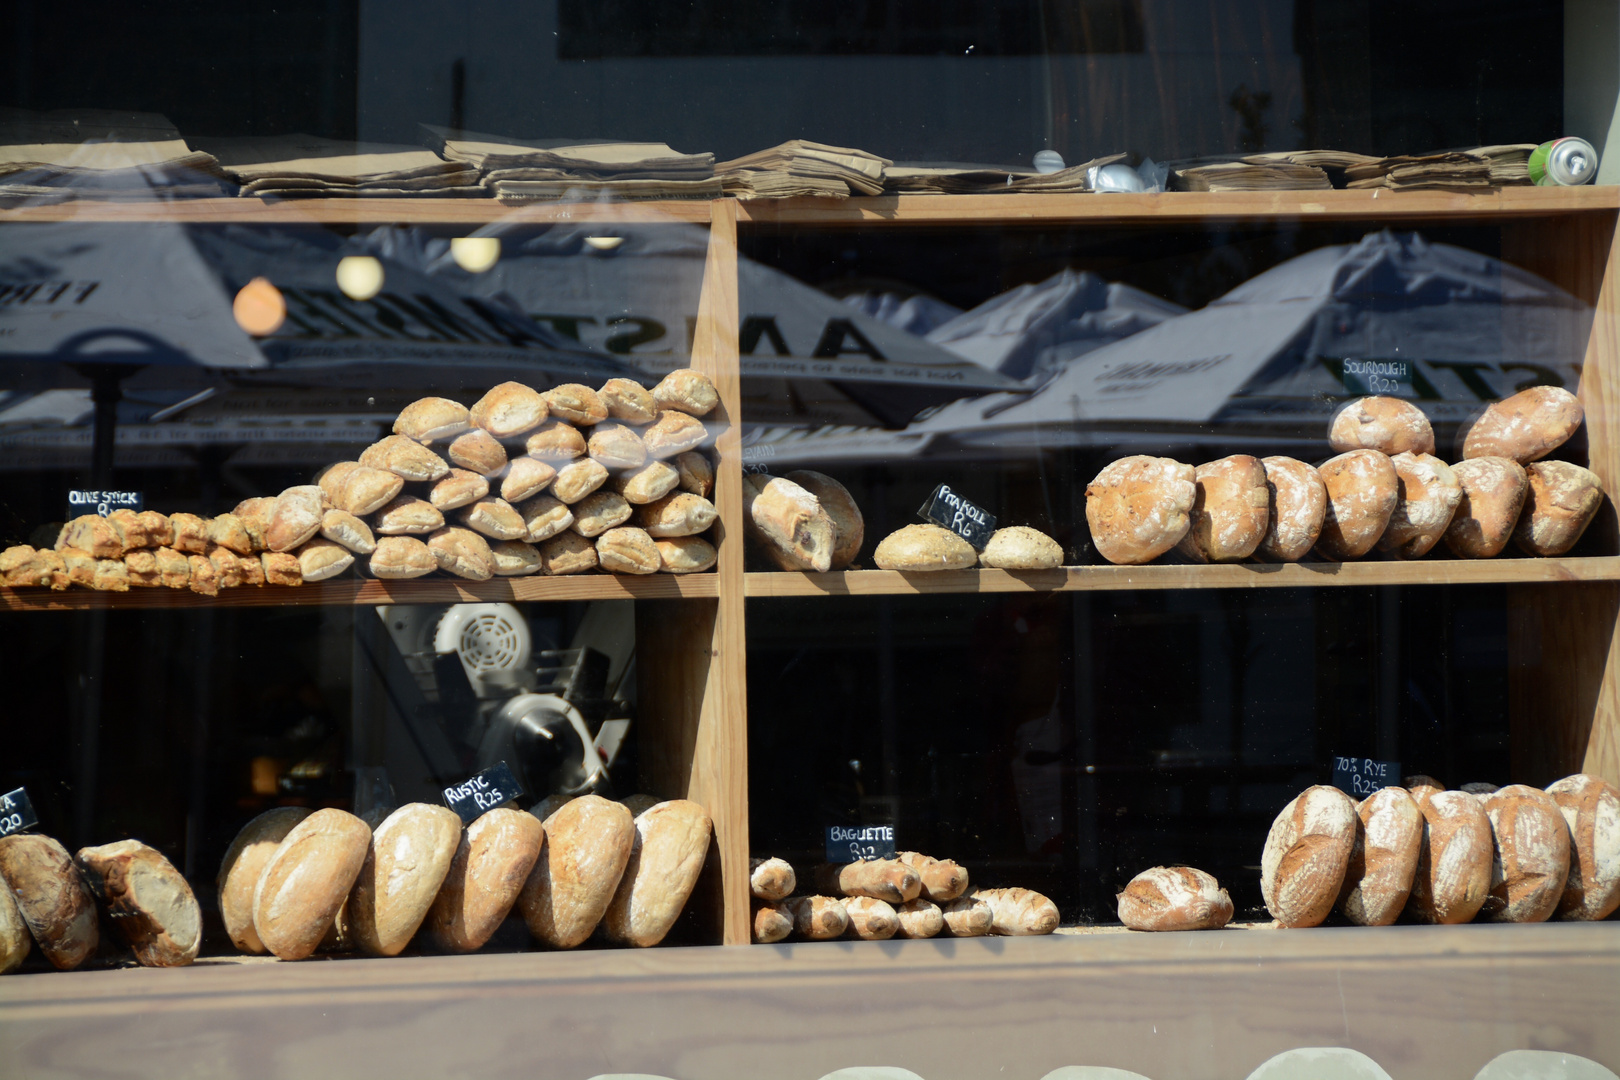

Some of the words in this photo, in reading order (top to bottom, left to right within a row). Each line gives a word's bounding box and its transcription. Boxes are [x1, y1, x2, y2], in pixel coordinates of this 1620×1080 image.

[1344, 358, 1407, 376] SOURDOUGH
[1369, 374, 1399, 392] R20
[69, 490, 100, 504] OLIVE
[101, 490, 139, 504] STICK
[951, 511, 972, 537] R6
[1336, 756, 1358, 773] 70%
[1364, 758, 1388, 777] RYE
[444, 775, 490, 805] RUSTIC
[1352, 773, 1380, 794] R25
[474, 788, 503, 810] R25
[830, 825, 894, 842] BAGUETTE
